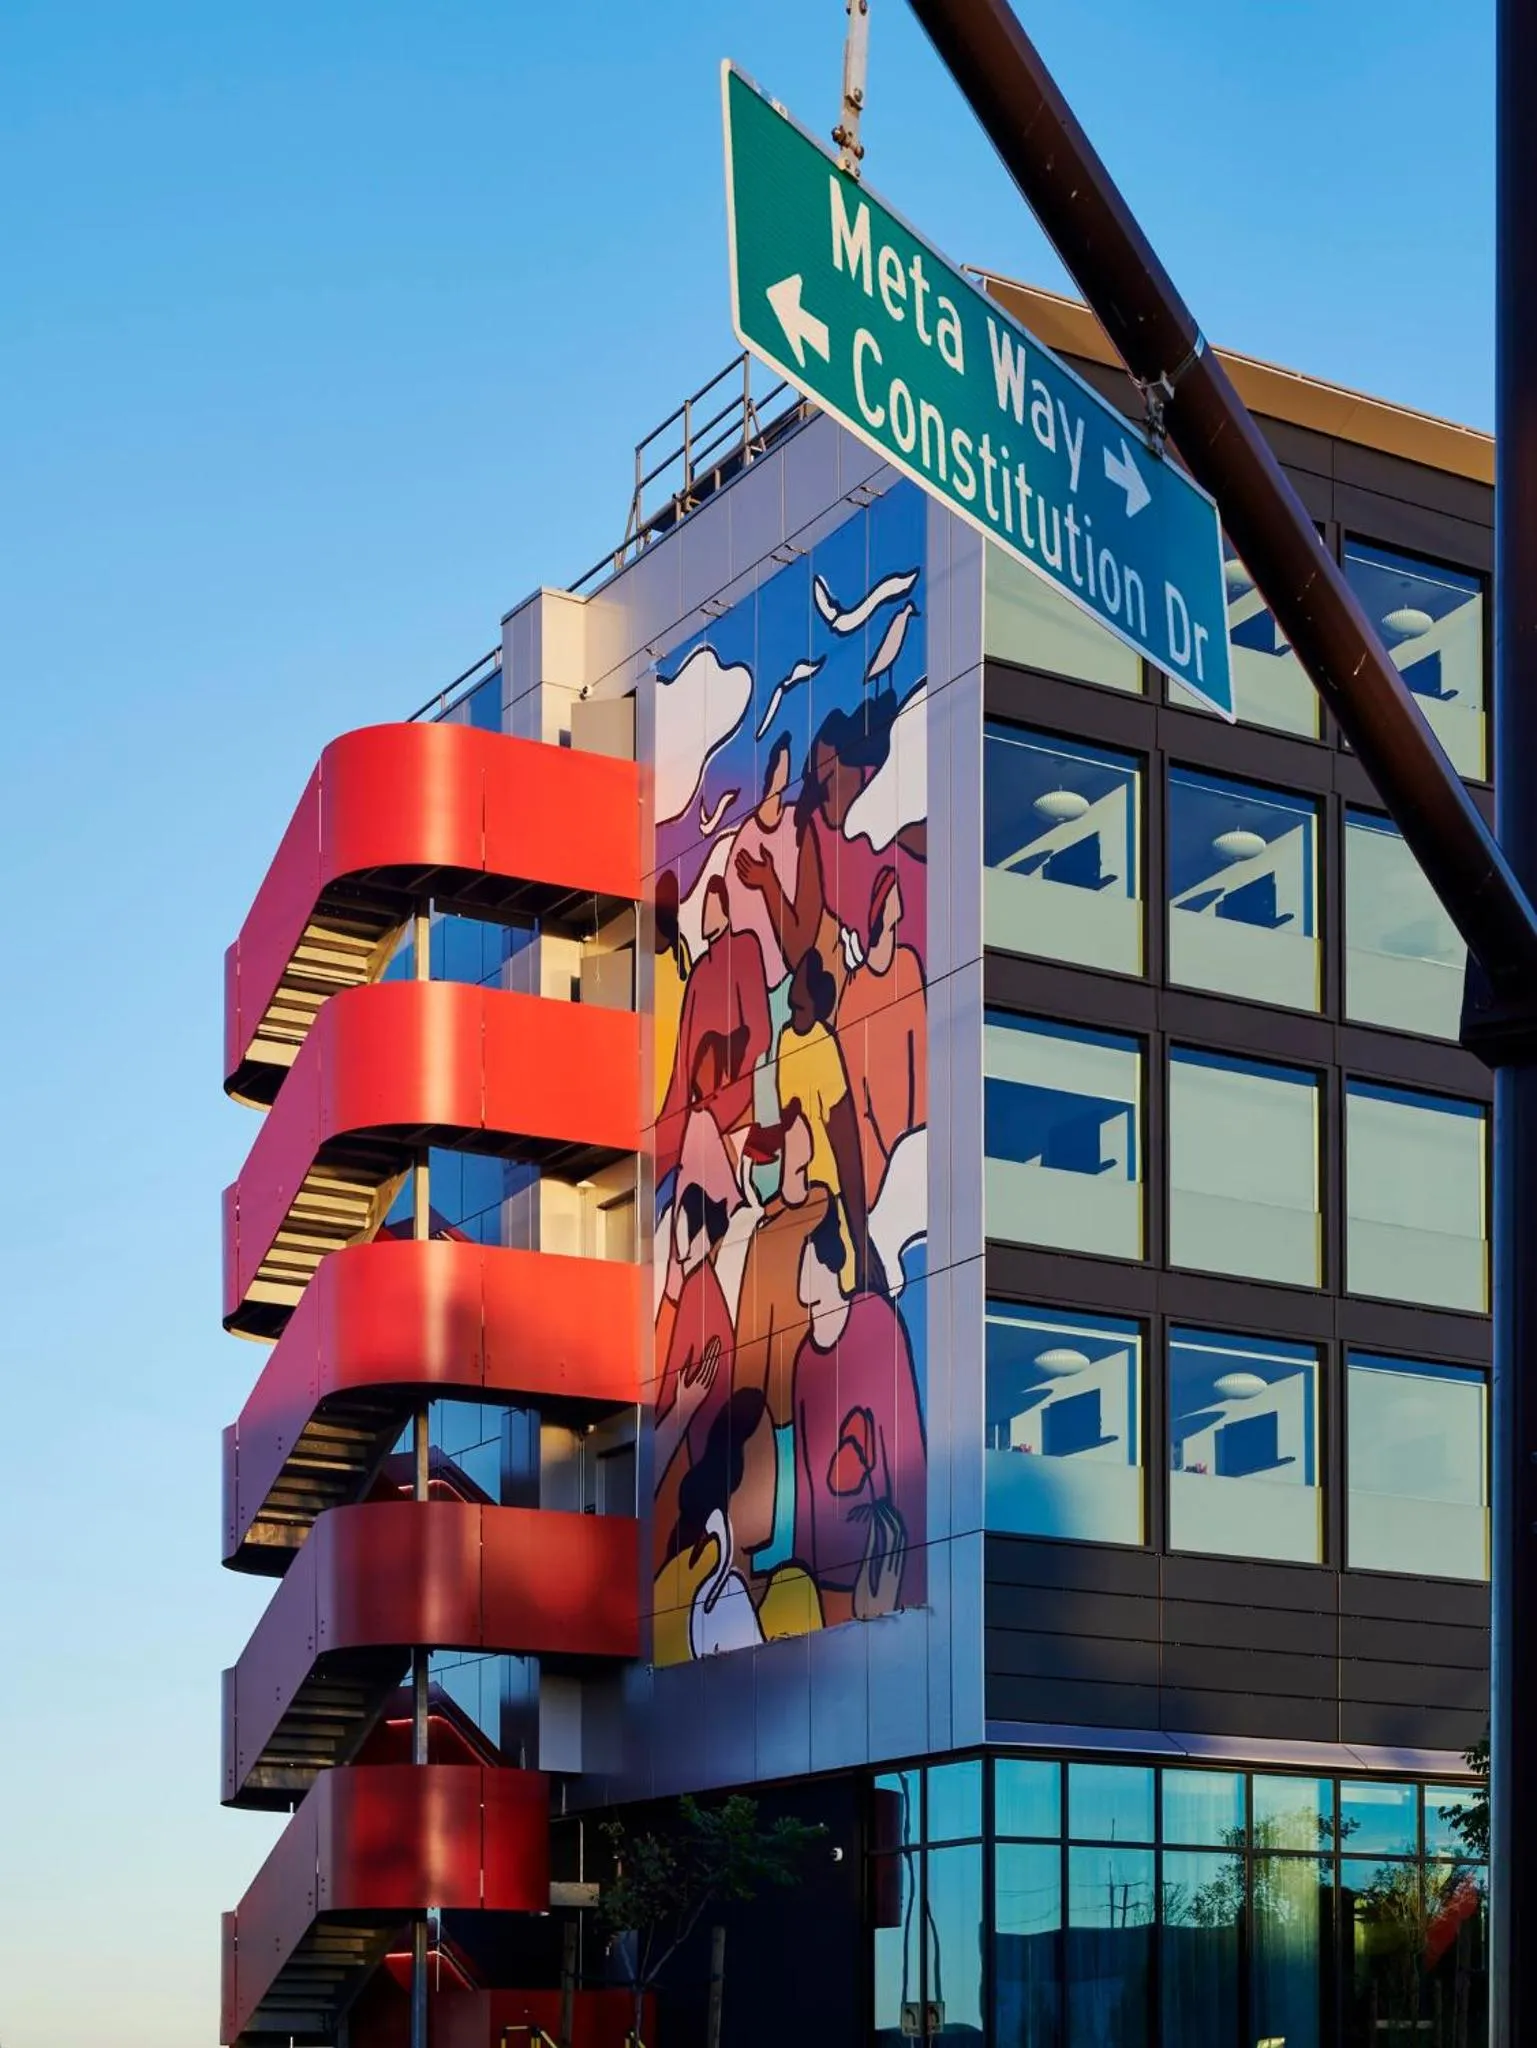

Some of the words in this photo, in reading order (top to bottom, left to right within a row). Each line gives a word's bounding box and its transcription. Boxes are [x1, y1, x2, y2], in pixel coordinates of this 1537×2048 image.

[829, 176, 965, 374] Meta
[987, 317, 1084, 491] Way
[853, 328, 1147, 637] Constitution
[1165, 583, 1209, 681] Dr
